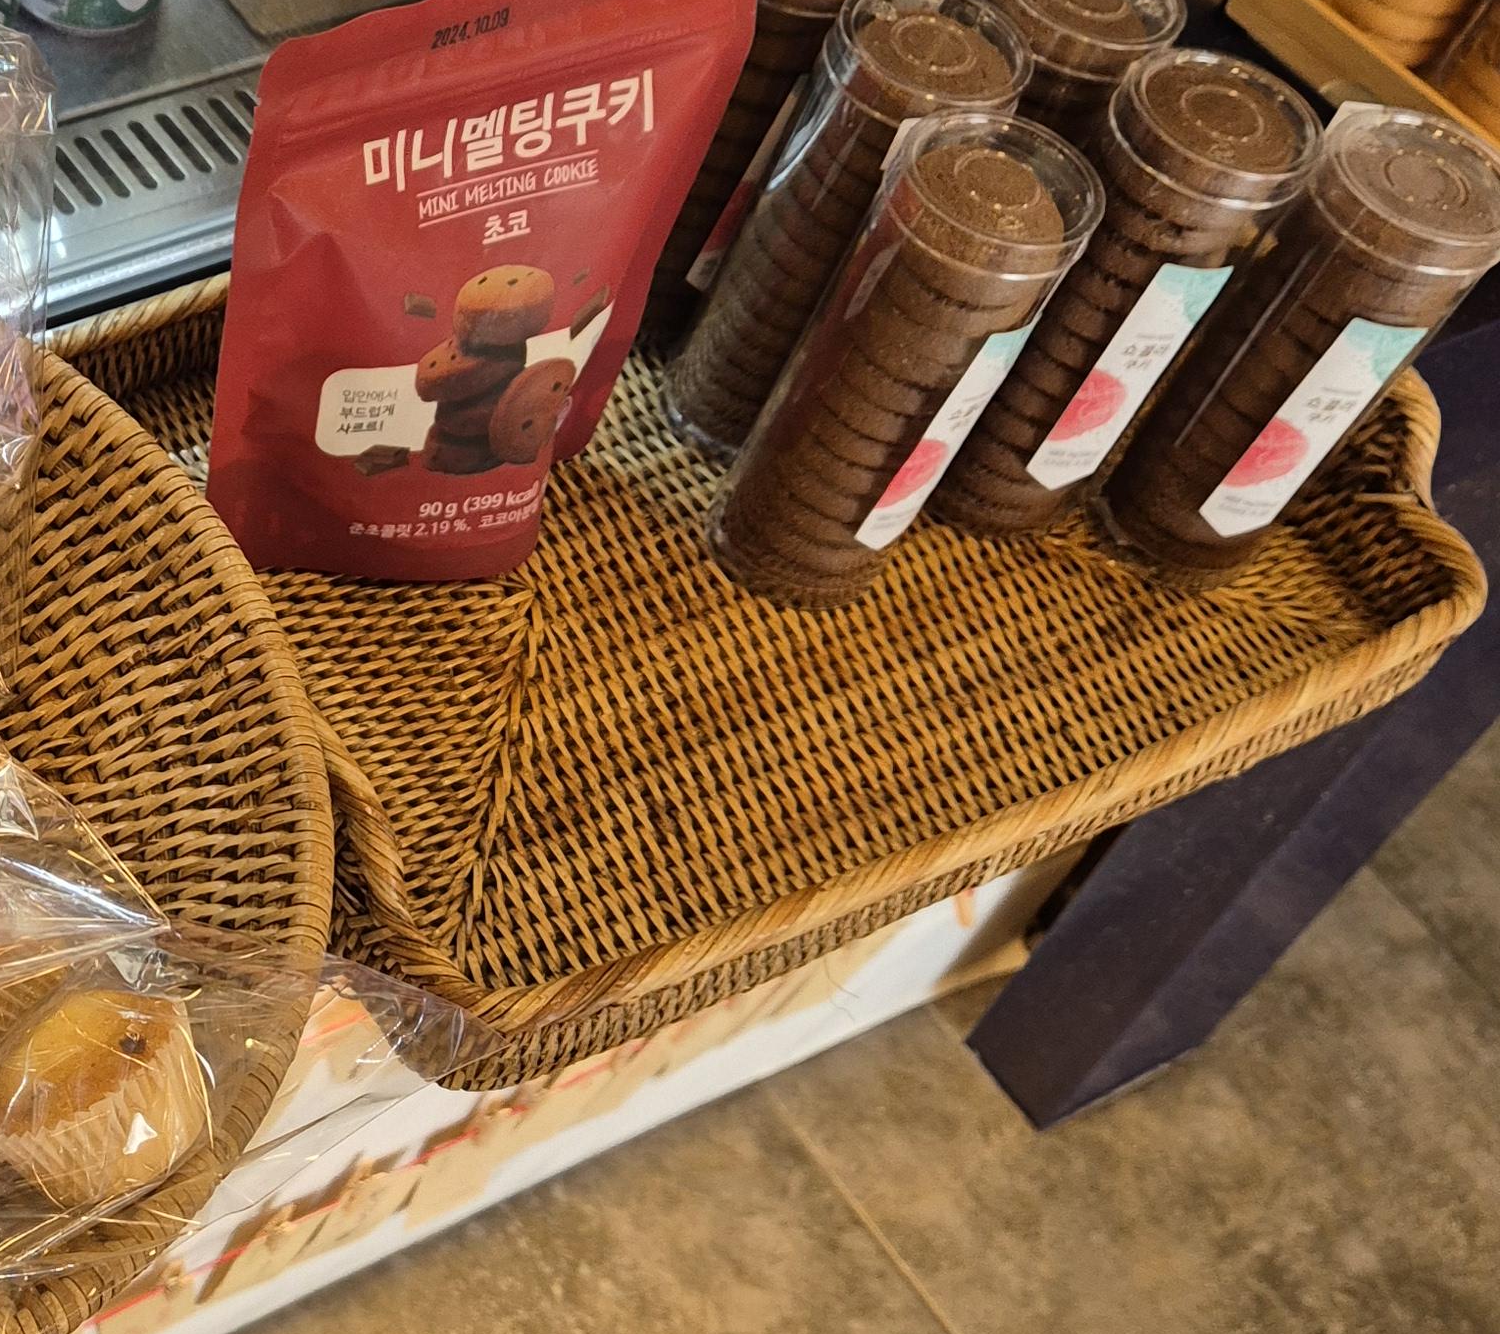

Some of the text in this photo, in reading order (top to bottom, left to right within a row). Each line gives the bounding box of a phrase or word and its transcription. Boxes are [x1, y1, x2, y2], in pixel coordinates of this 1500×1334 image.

[363, 68, 654, 192] 미니멜팅쿠키
[419, 157, 599, 219] MINI MELTING COOKIE
[482, 209, 531, 245] 초코
[340, 403, 396, 420] 부드럽게
[342, 388, 398, 404] 입안에서
